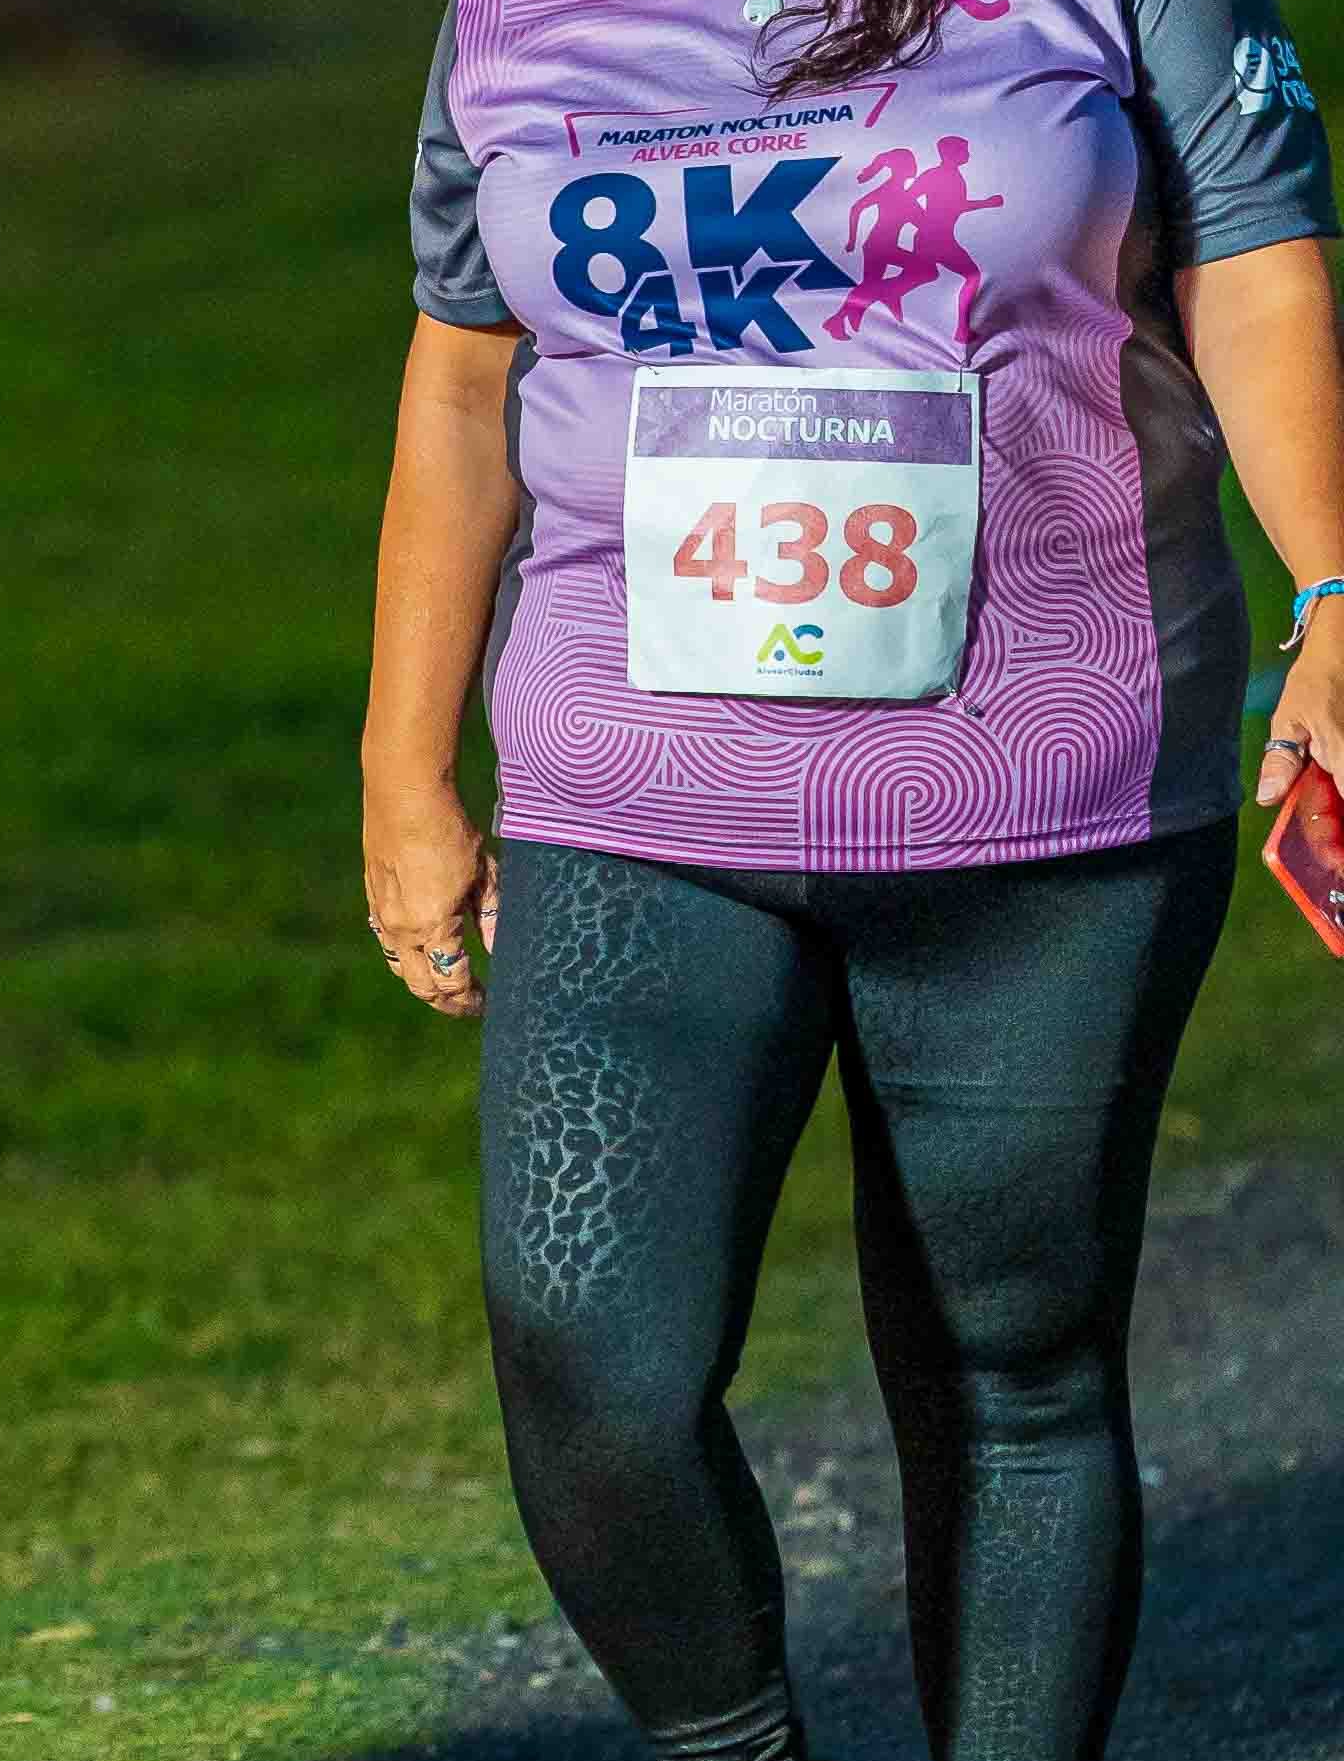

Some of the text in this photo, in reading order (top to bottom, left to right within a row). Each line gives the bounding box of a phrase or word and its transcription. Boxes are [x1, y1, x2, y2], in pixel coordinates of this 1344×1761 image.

[596, 104, 854, 146] MARATON NOCTURNA
[631, 132, 808, 163] ALVEAR CORRE
[548, 154, 860, 318] 8K
[620, 262, 815, 358] 4K
[710, 389, 818, 415] Maratón
[708, 415, 895, 446] NOCTURNA
[673, 501, 919, 608] 438
